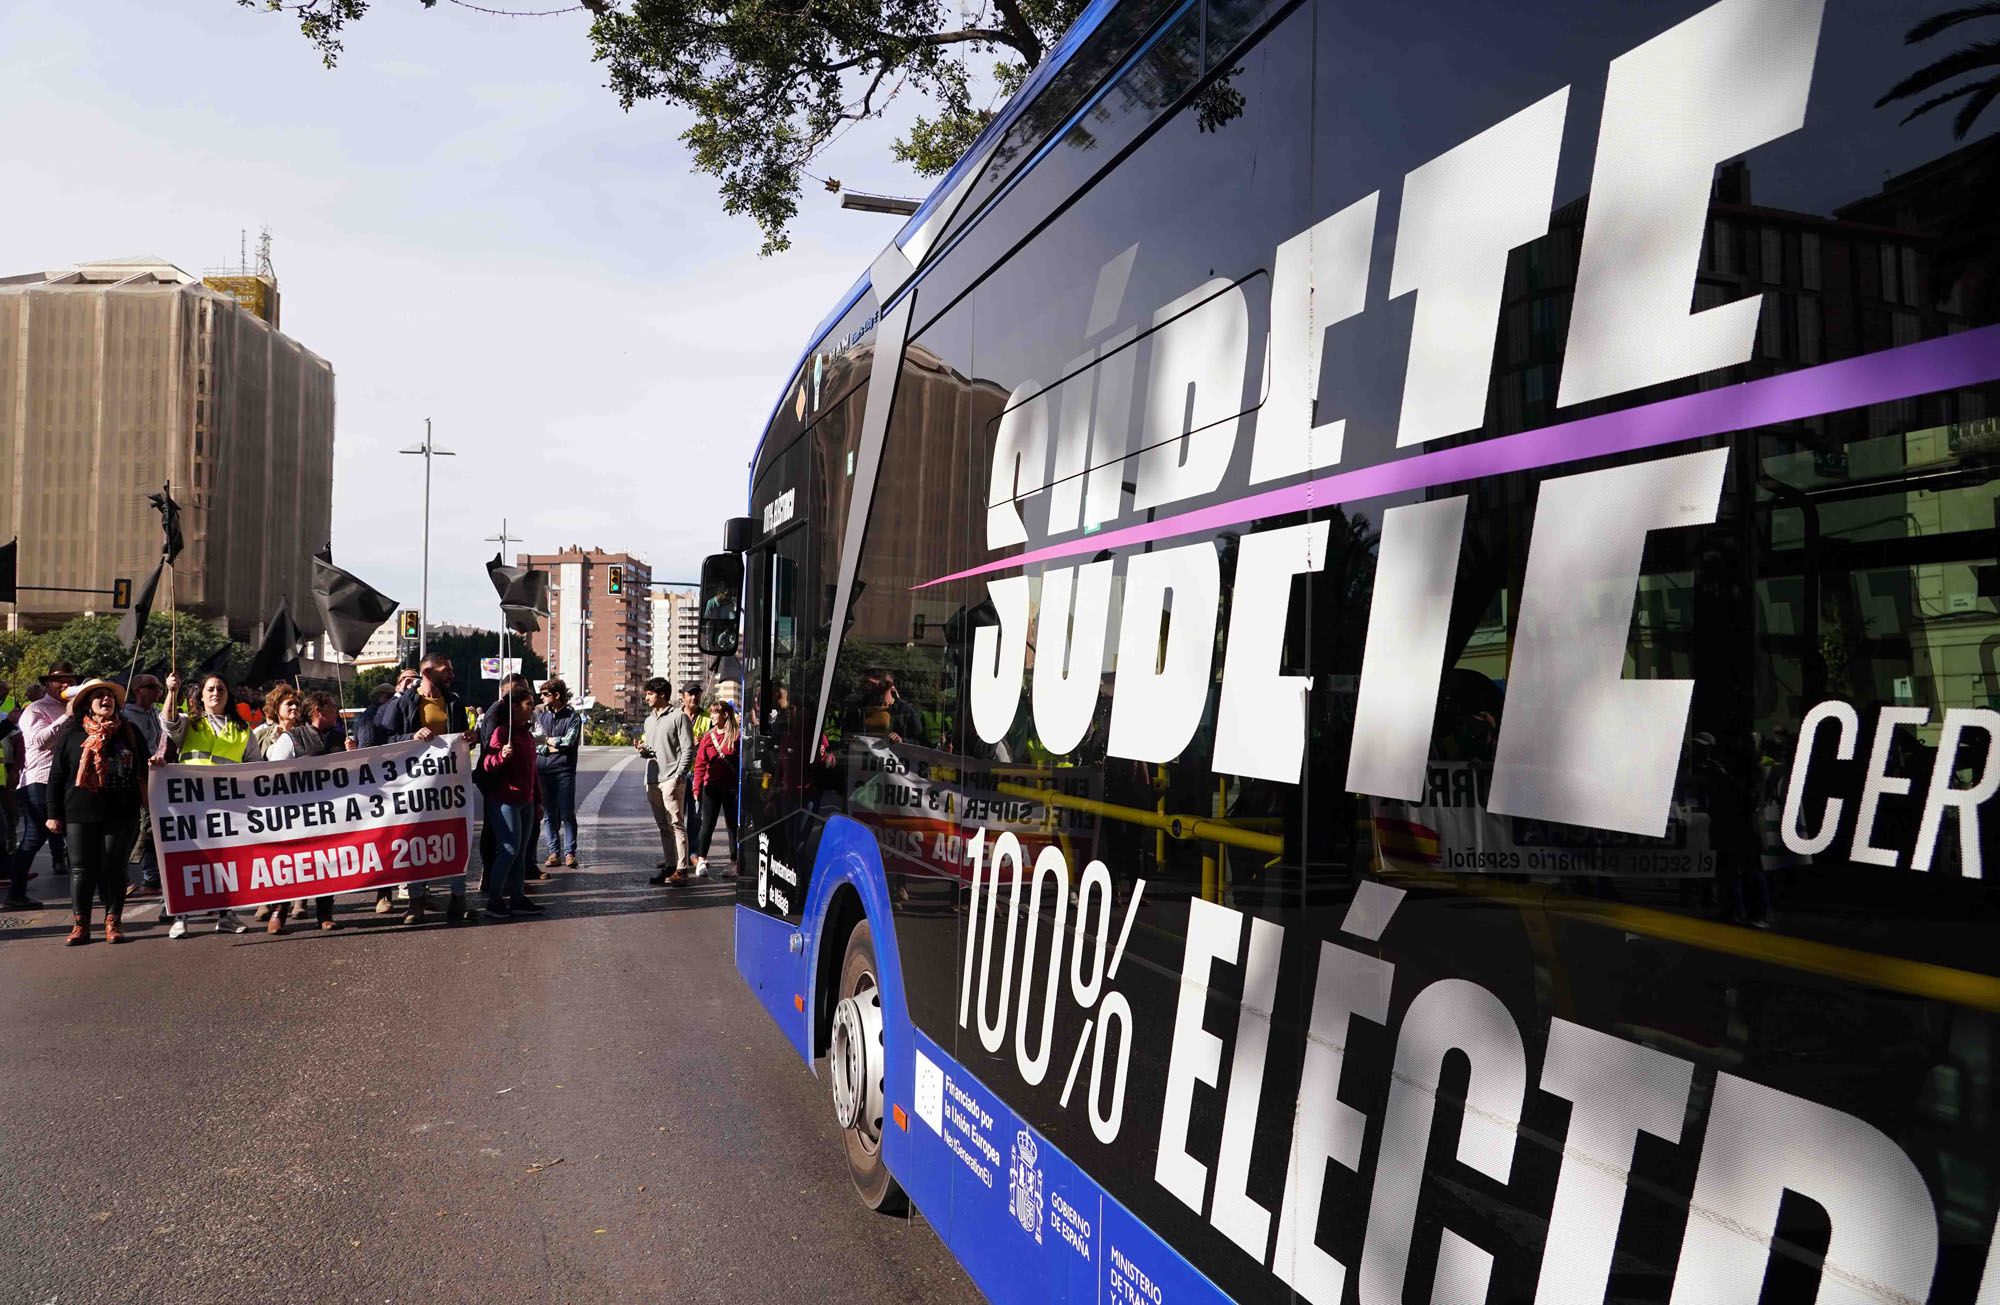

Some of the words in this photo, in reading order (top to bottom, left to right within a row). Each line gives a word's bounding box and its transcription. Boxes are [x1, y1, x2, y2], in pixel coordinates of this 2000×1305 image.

[167, 777, 204, 804] EN
[214, 777, 246, 801] EL
[253, 767, 349, 797] CAMPO
[358, 763, 376, 785] A
[382, 760, 398, 781] 3
[406, 751, 458, 778] Cént
[160, 815, 198, 842] EN
[207, 812, 240, 838] EL
[248, 801, 337, 834] SUPER
[346, 797, 362, 822] A
[370, 794, 385, 818] 3
[393, 784, 466, 816] EUROS
[182, 861, 239, 897] FIN
[250, 841, 384, 891] AGENDA
[391, 833, 456, 870] 2030
[958, 825, 1146, 1145] 100%
[945, 1074, 980, 1120] Financiado
[981, 1110, 994, 1132] por
[943, 1127, 993, 1190] NextGenerationEU
[944, 1099, 951, 1119] la
[951, 1102, 970, 1140] Unión
[971, 1124, 1000, 1168] Europea
[1051, 1191, 1091, 1238] GOBIERNO
[1051, 1211, 1061, 1233] DE
[1061, 1223, 1091, 1262] ESPAÑA
[1110, 1245, 1162, 1305] MINISTERIO
[1110, 1268, 1123, 1294] DE
